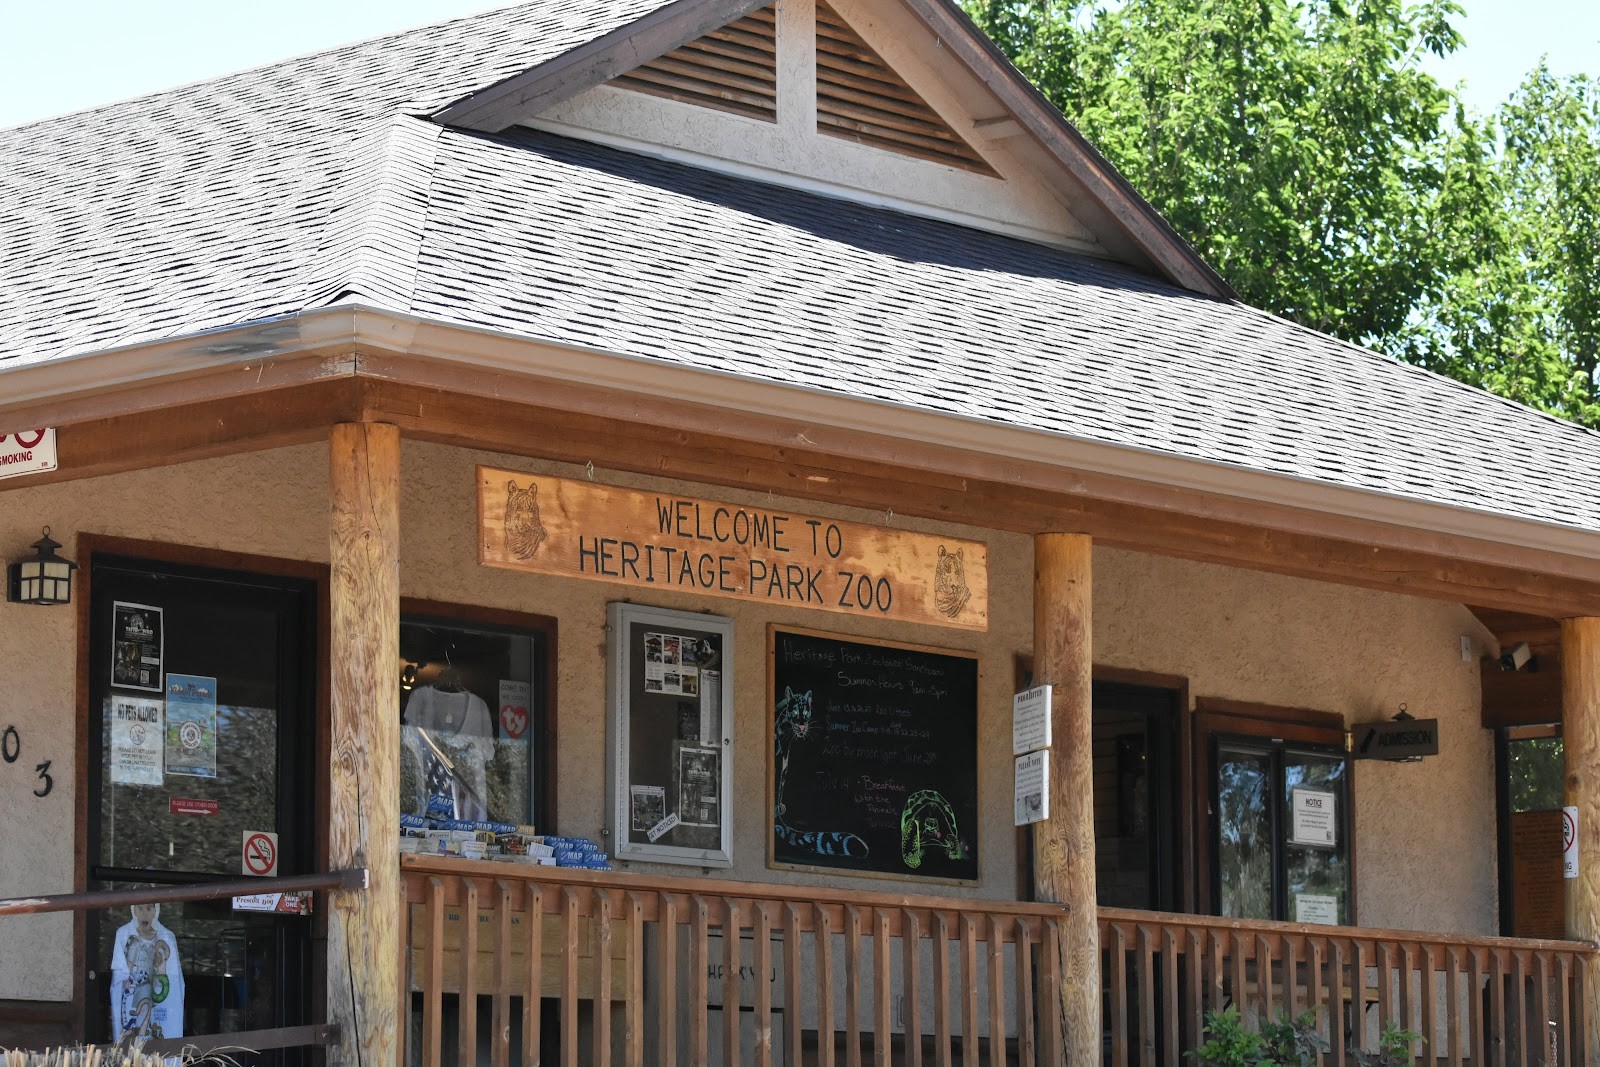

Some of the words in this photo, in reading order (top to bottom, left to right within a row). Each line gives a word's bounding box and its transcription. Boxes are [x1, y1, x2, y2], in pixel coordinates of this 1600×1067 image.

[657, 497, 790, 552] WELCOME
[805, 519, 842, 559] TO
[580, 535, 737, 593] HERITAGE
[749, 558, 824, 605] PARK
[838, 571, 892, 613] ZOO
[783, 639, 836, 667] Heritage
[838, 671, 875, 688] Summer
[126, 704, 137, 721] PETS
[138, 706, 158, 723] ALLOWED
[503, 706, 526, 735] ty
[1378, 730, 1432, 746] ADMISSION
[34, 760, 53, 797] 3
[437, 796, 454, 806] MAP
[1306, 798, 1322, 807] NOTICE
[406, 816, 423, 826] MAP
[457, 823, 473, 831] MAP
[476, 822, 492, 831] MAP
[499, 825, 516, 834] MAP
[558, 842, 574, 850] MAP
[567, 852, 583, 860] MAP
[592, 854, 608, 862] MAP
